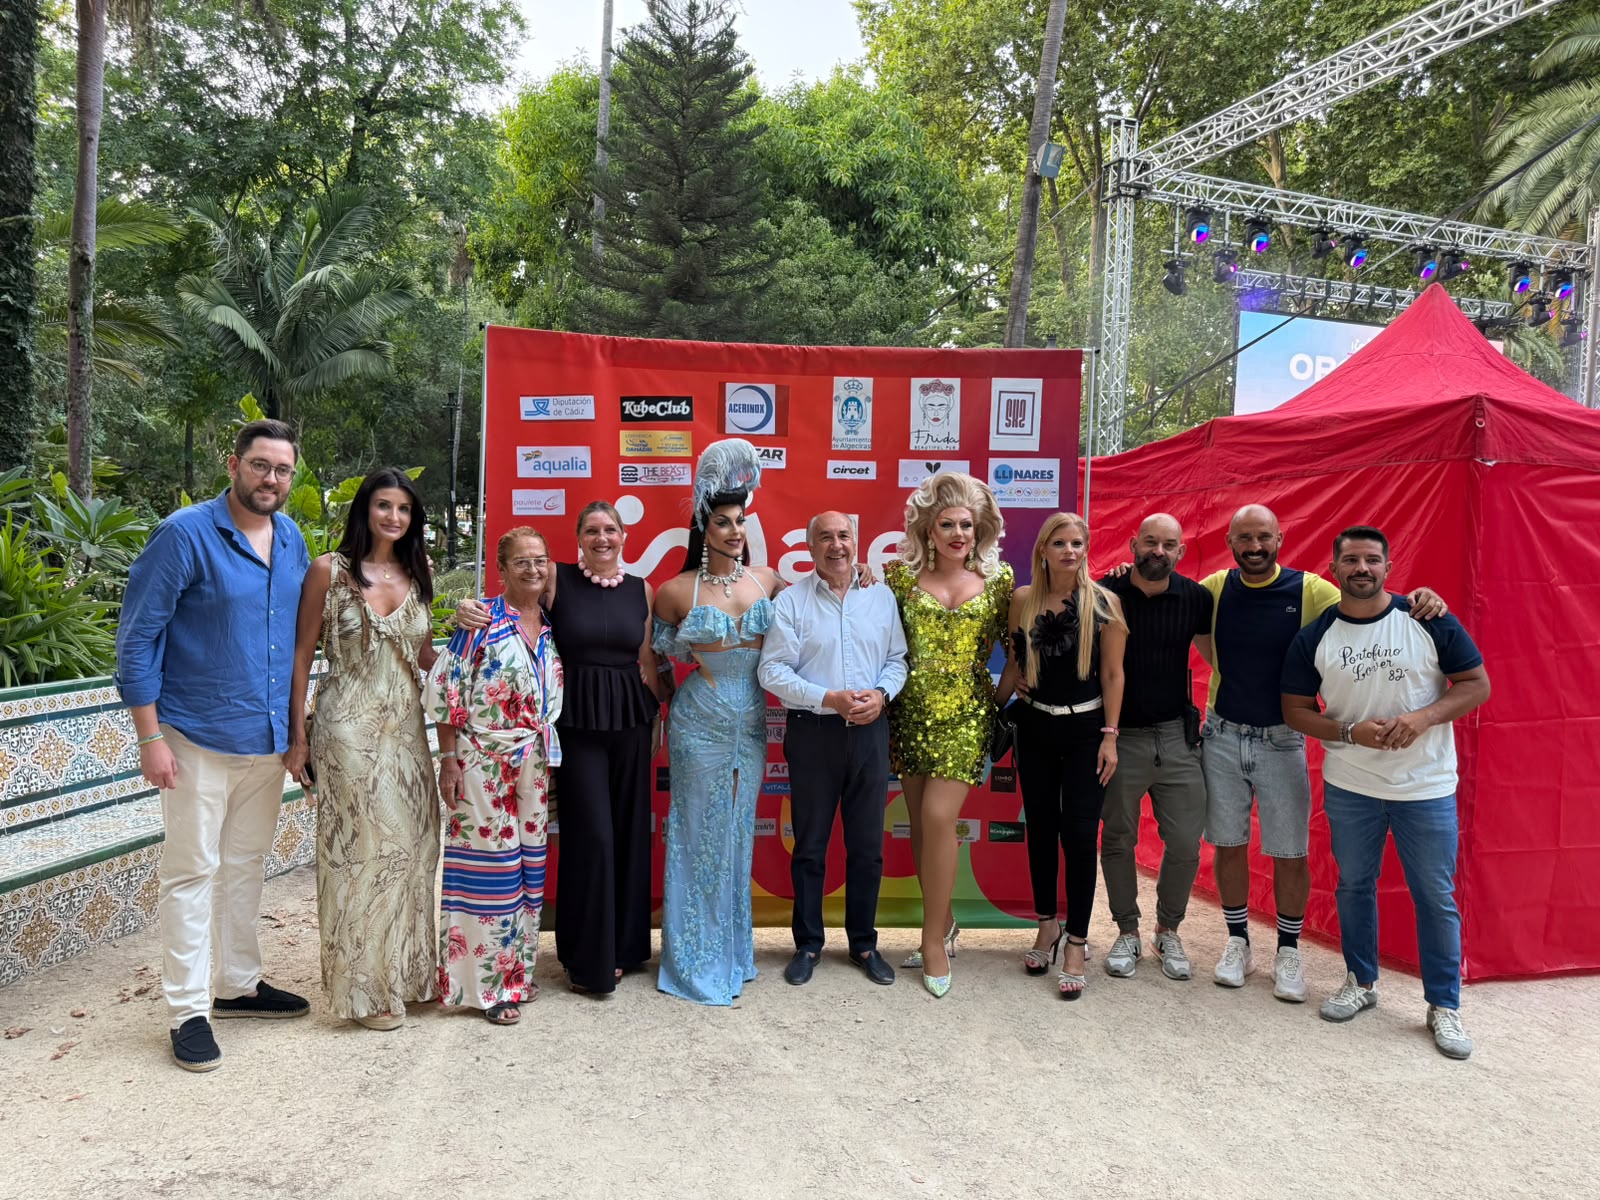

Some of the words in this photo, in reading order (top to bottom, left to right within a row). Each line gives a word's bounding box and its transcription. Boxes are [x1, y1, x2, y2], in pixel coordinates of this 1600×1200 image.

[552, 397, 592, 406] Diputación
[553, 408, 562, 416] de
[564, 407, 585, 416] Cádiz
[622, 400, 690, 418] KubeClub
[728, 403, 765, 414] ACERINOX
[910, 429, 960, 445] Frida
[840, 442, 871, 450] Algeciras
[533, 457, 587, 474] aqualia
[642, 467, 658, 476] THE
[660, 465, 687, 476] BEAST
[832, 465, 870, 475] circet
[995, 470, 1054, 480] LLINARES
[1338, 643, 1404, 670] Portofino
[1353, 660, 1394, 682] Lover
